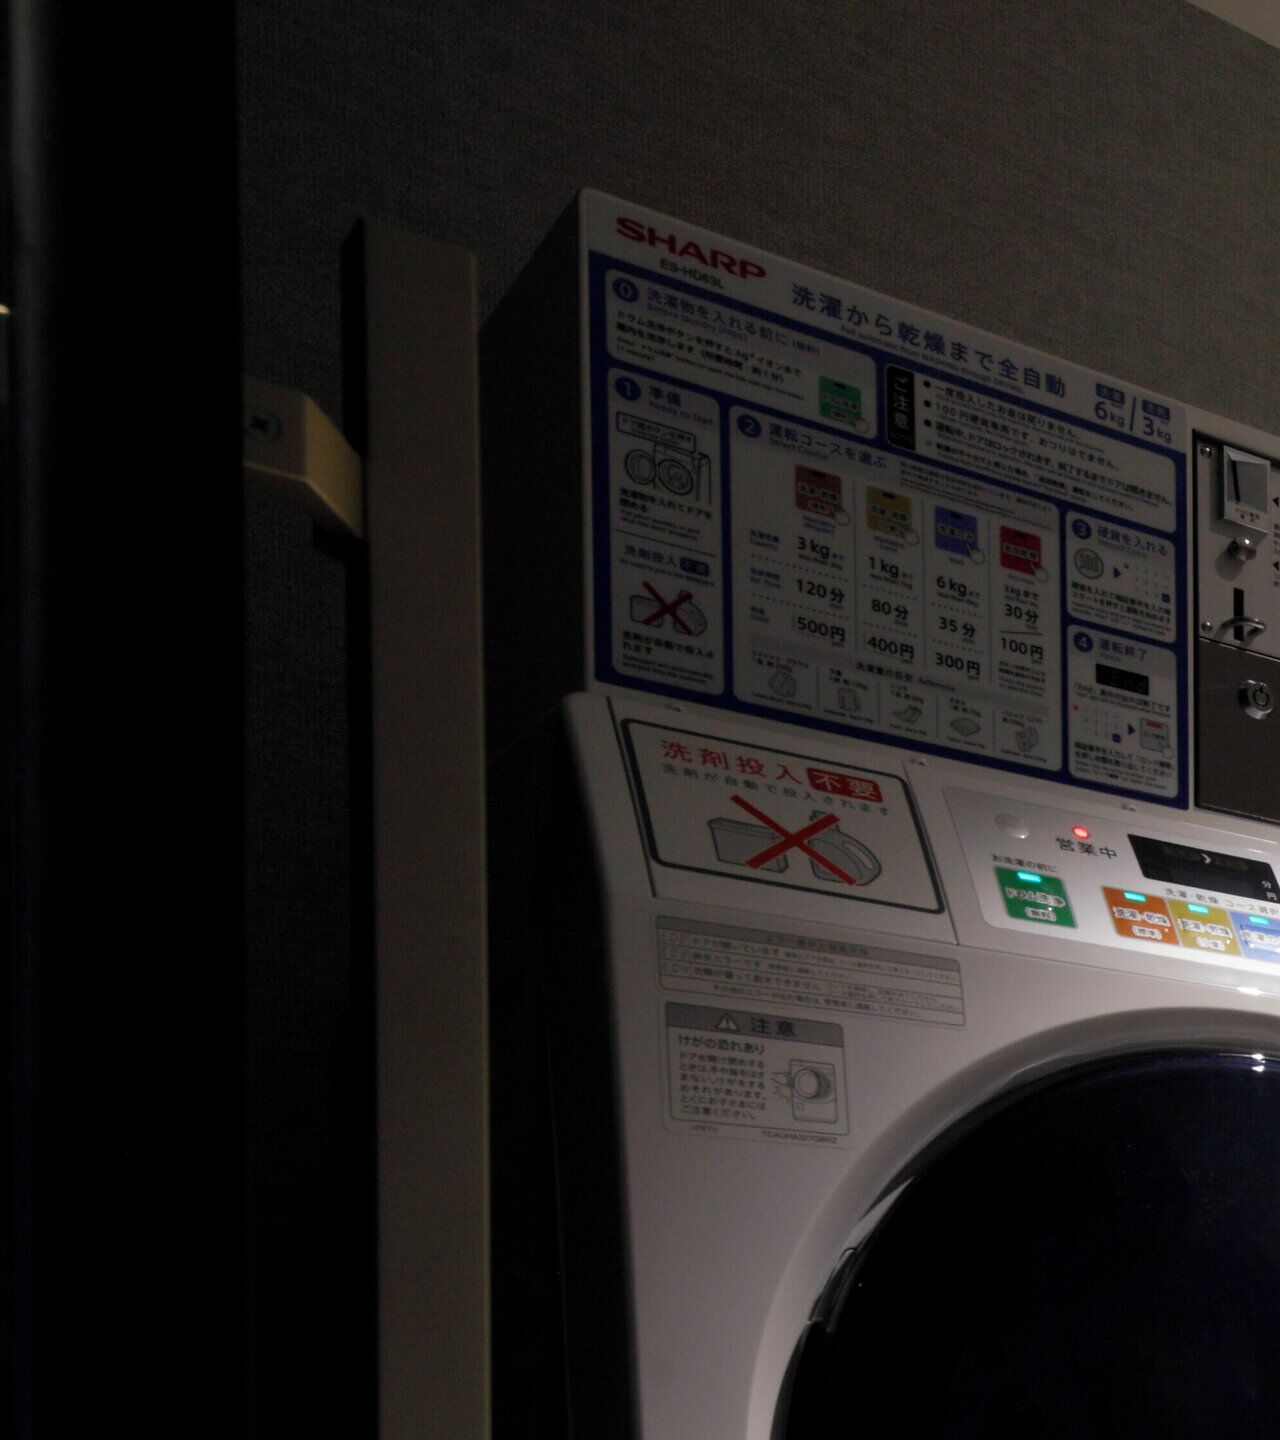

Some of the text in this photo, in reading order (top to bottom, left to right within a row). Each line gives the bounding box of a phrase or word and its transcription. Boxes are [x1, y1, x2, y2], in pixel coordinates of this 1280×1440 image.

[615, 214, 766, 286] SHARP
[646, 287, 787, 346] 洗濯物を入れる前に
[791, 282, 1065, 398] 洗濯から乾燥まで全自動
[648, 384, 680, 407] 準備
[768, 421, 887, 470] 運転コースを選ぶ
[1097, 524, 1167, 556] 硬貨を入れる
[796, 578, 845, 605] 120分
[871, 597, 910, 622] 80分
[1004, 602, 1039, 625] 30分
[797, 616, 845, 642] 500円
[938, 615, 976, 639] 35分
[866, 633, 914, 659] 400円
[1000, 635, 1043, 660] 100円
[1099, 637, 1147, 662] 運転終了
[935, 651, 980, 676] 300円
[658, 738, 879, 801] 洗剤投入 不要
[662, 763, 889, 816] 洗剤が自動で投入されます
[1054, 836, 1120, 862] 営業中
[990, 852, 1058, 874] お洗濯の前に
[750, 1016, 796, 1037] 注意
[678, 1034, 764, 1054] けがの恐れあり
